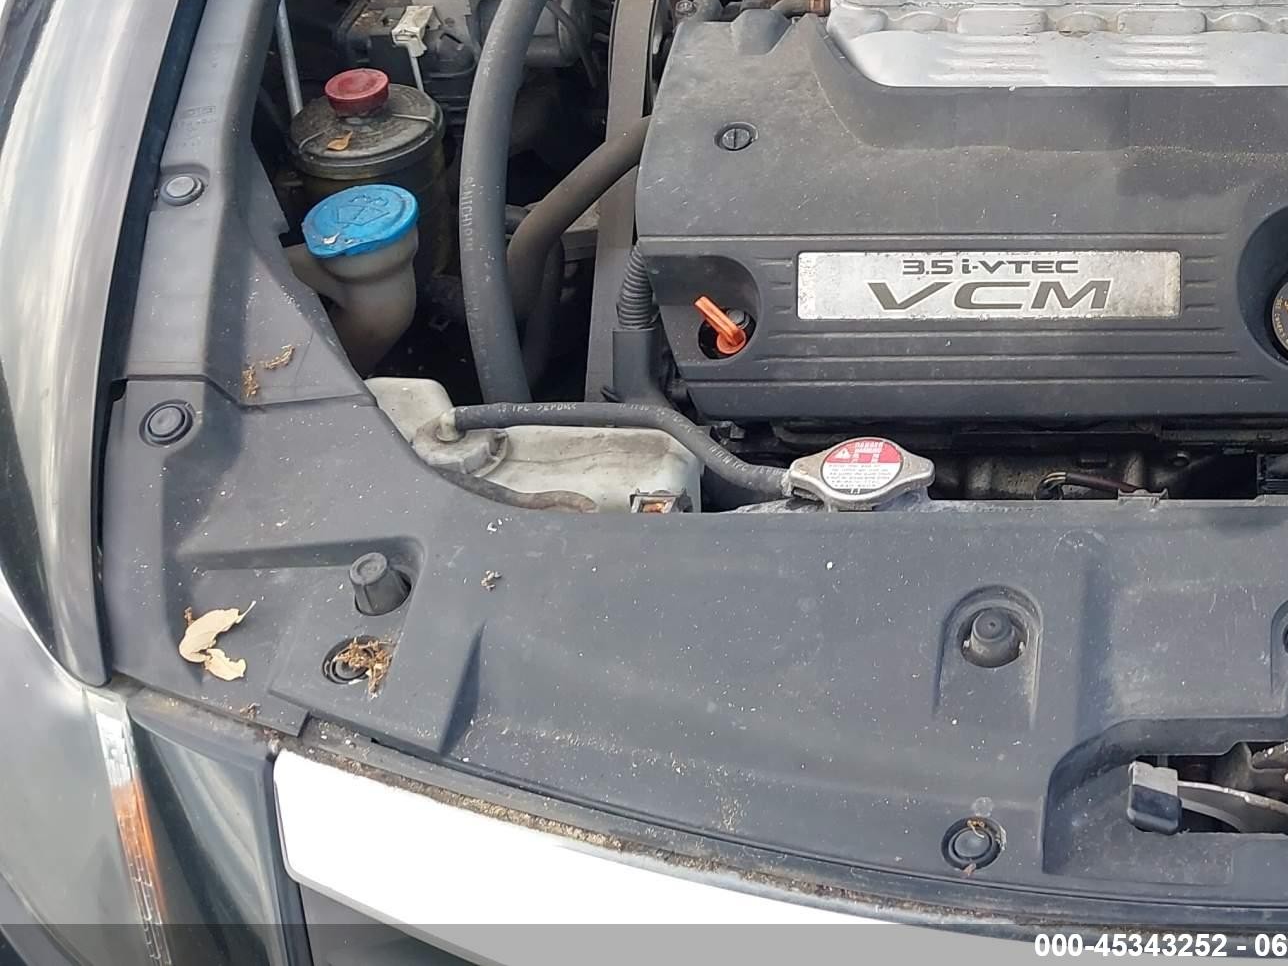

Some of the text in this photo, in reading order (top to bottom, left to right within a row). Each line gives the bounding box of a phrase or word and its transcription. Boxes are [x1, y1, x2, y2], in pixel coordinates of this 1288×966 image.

[902, 259, 1079, 275] 3.5 i-VTEC
[867, 280, 1112, 310] VCM
